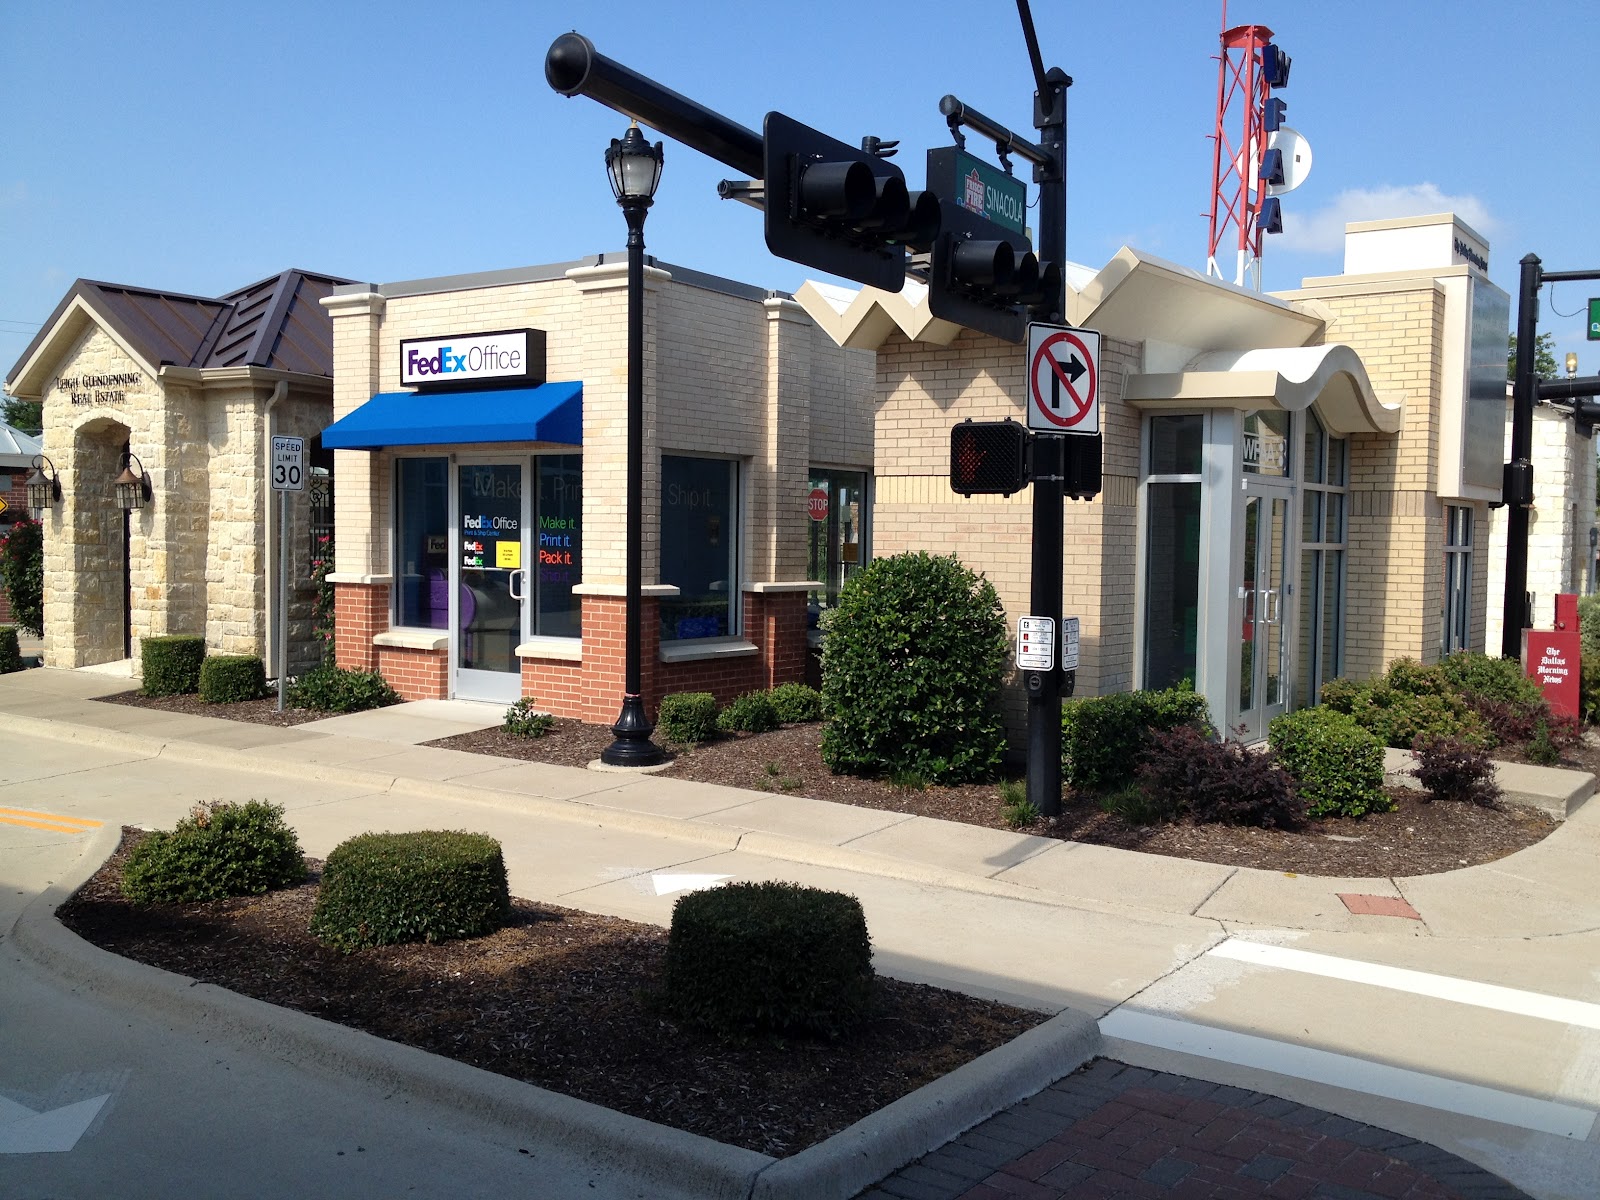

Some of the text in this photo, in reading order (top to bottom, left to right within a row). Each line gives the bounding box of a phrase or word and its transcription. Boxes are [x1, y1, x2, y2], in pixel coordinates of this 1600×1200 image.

[966, 189, 983, 210] FIRE
[986, 185, 1023, 225] SINACOLA
[408, 345, 521, 375] FedEx Office
[57, 377, 79, 389] LEIGH
[71, 390, 125, 405] REAL ESTATE
[275, 442, 301, 452] SPEED
[277, 454, 298, 463] LIMIT
[275, 465, 301, 484] 30
[667, 483, 699, 510] Ship
[808, 498, 829, 511] STOP
[464, 515, 518, 530] FedEx Office
[539, 516, 577, 530] Make it.
[464, 541, 483, 551] FedEx
[539, 533, 572, 548] Print it.
[464, 556, 483, 566] FedEx
[539, 550, 573, 565] Pack it.
[1546, 647, 1561, 656] The
[1541, 656, 1566, 666] Dallas
[1537, 665, 1568, 676] Morning
[1543, 675, 1562, 684] News
